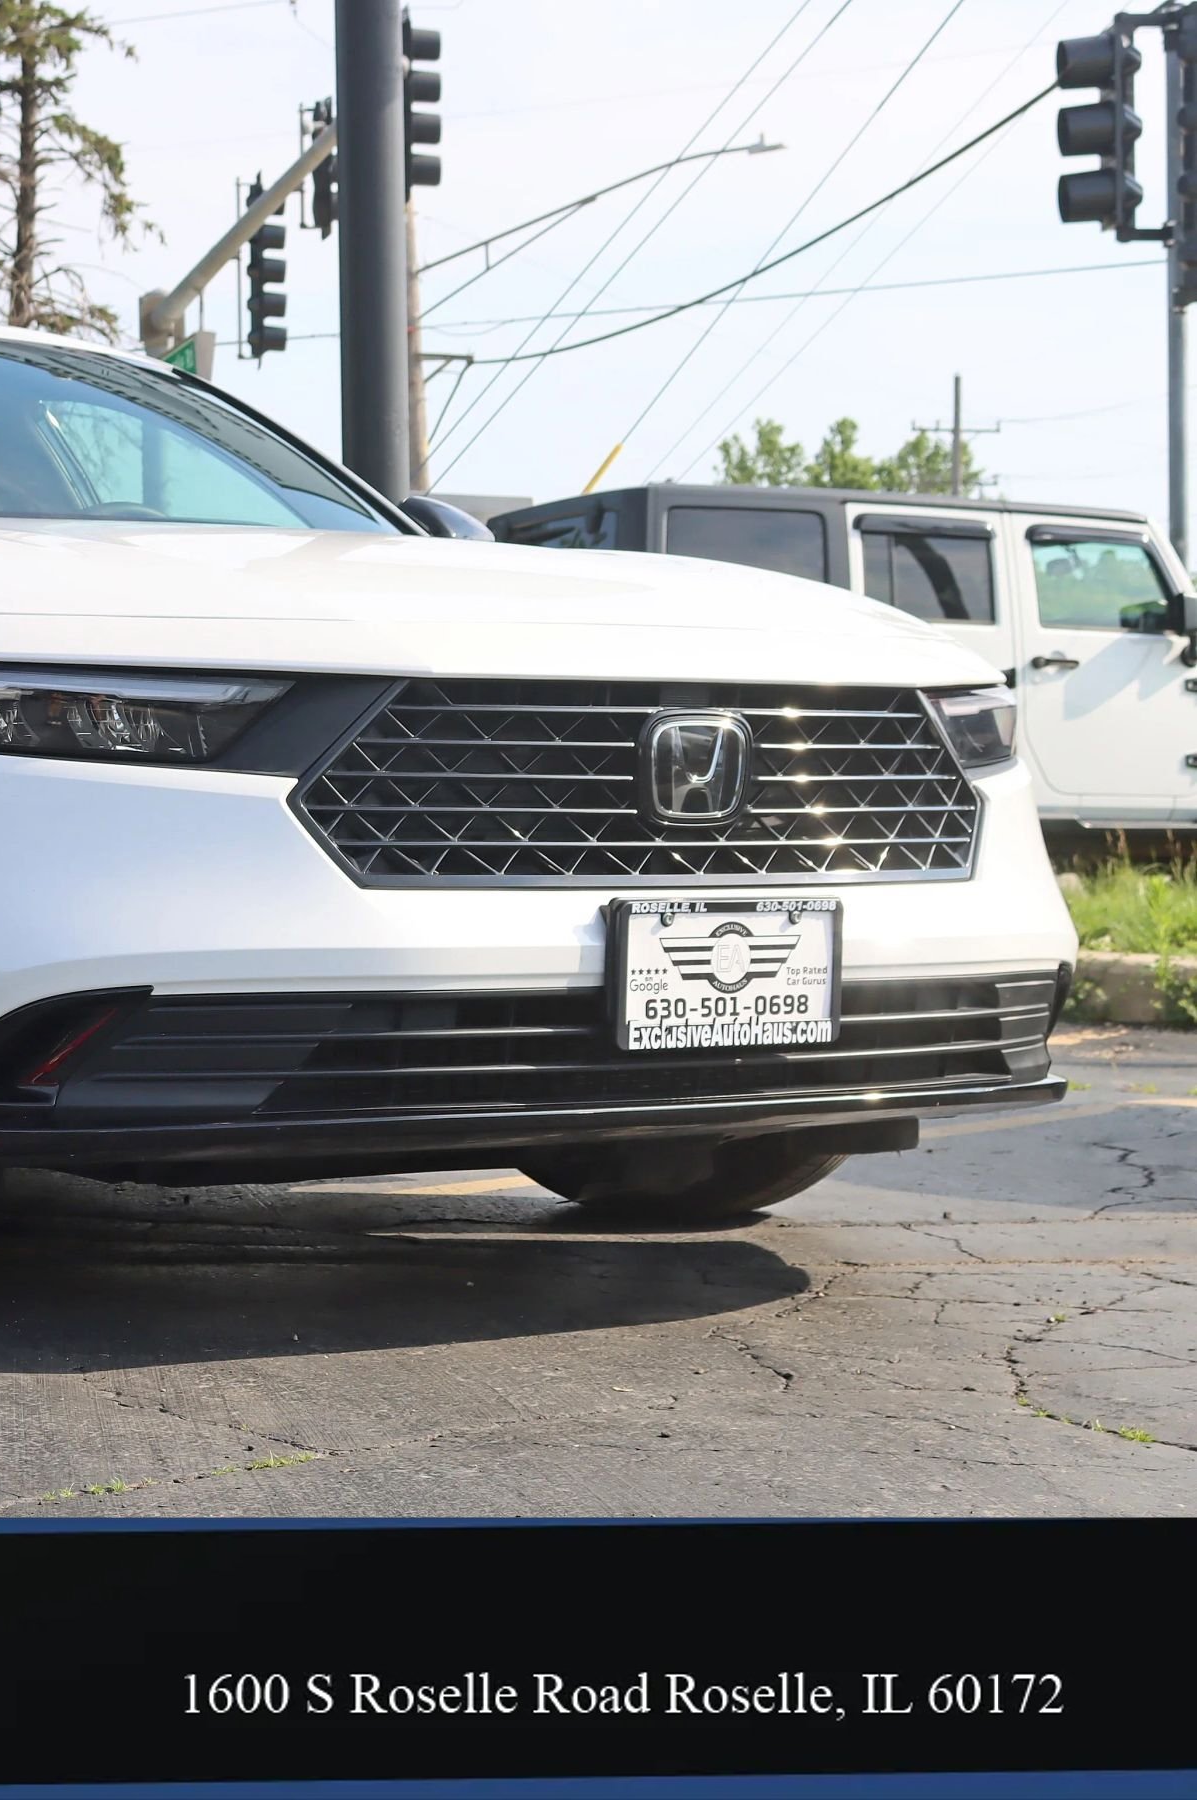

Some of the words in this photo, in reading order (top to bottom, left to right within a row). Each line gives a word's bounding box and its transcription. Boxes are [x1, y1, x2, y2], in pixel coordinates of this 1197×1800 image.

[631, 902, 691, 914] ROSELLE,
[695, 902, 708, 913] IL
[756, 900, 837, 912] 630-501-0698
[715, 923, 748, 937] EXCLUSIVE
[786, 966, 801, 976] Top
[803, 966, 828, 975] Rated
[630, 979, 669, 995] Google
[712, 977, 749, 992] AUTOHAUS
[786, 977, 800, 986] Car
[802, 977, 827, 986] Gurus
[645, 994, 809, 1020] 630-501-0698
[628, 1018, 833, 1050] ExclusiveAutoHaus.com
